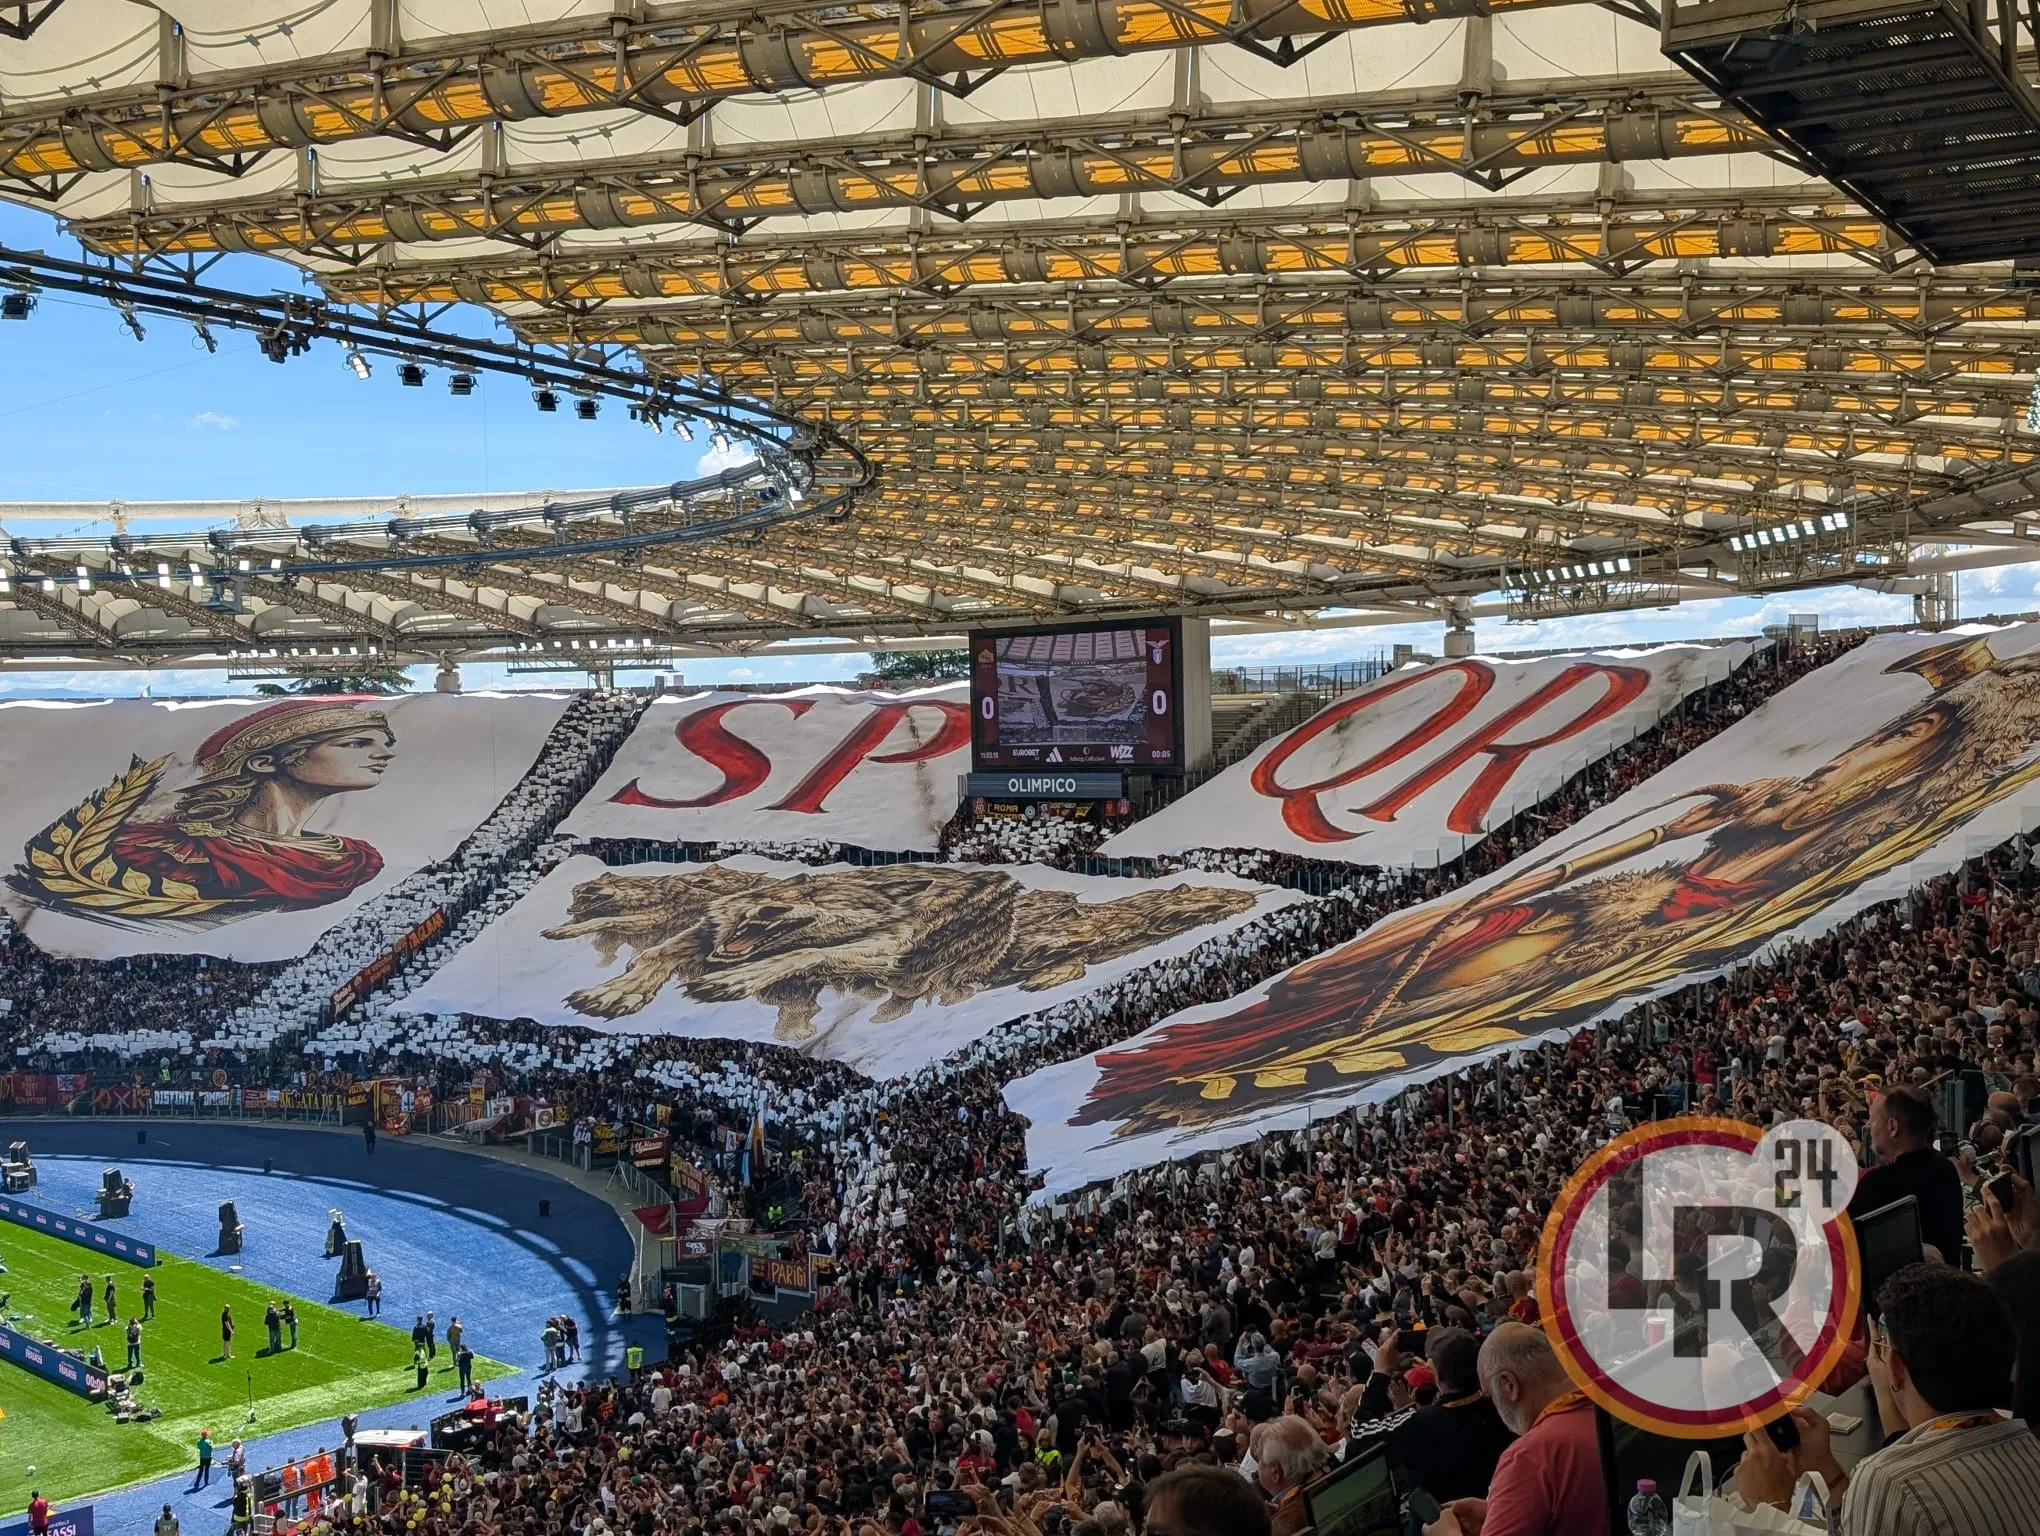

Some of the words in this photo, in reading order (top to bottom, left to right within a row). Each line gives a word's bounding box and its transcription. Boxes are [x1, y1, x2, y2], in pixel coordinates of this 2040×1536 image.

[982, 697, 994, 719] 0
[1152, 690, 1167, 715] 0
[1008, 778, 1077, 793] OLIMPICO
